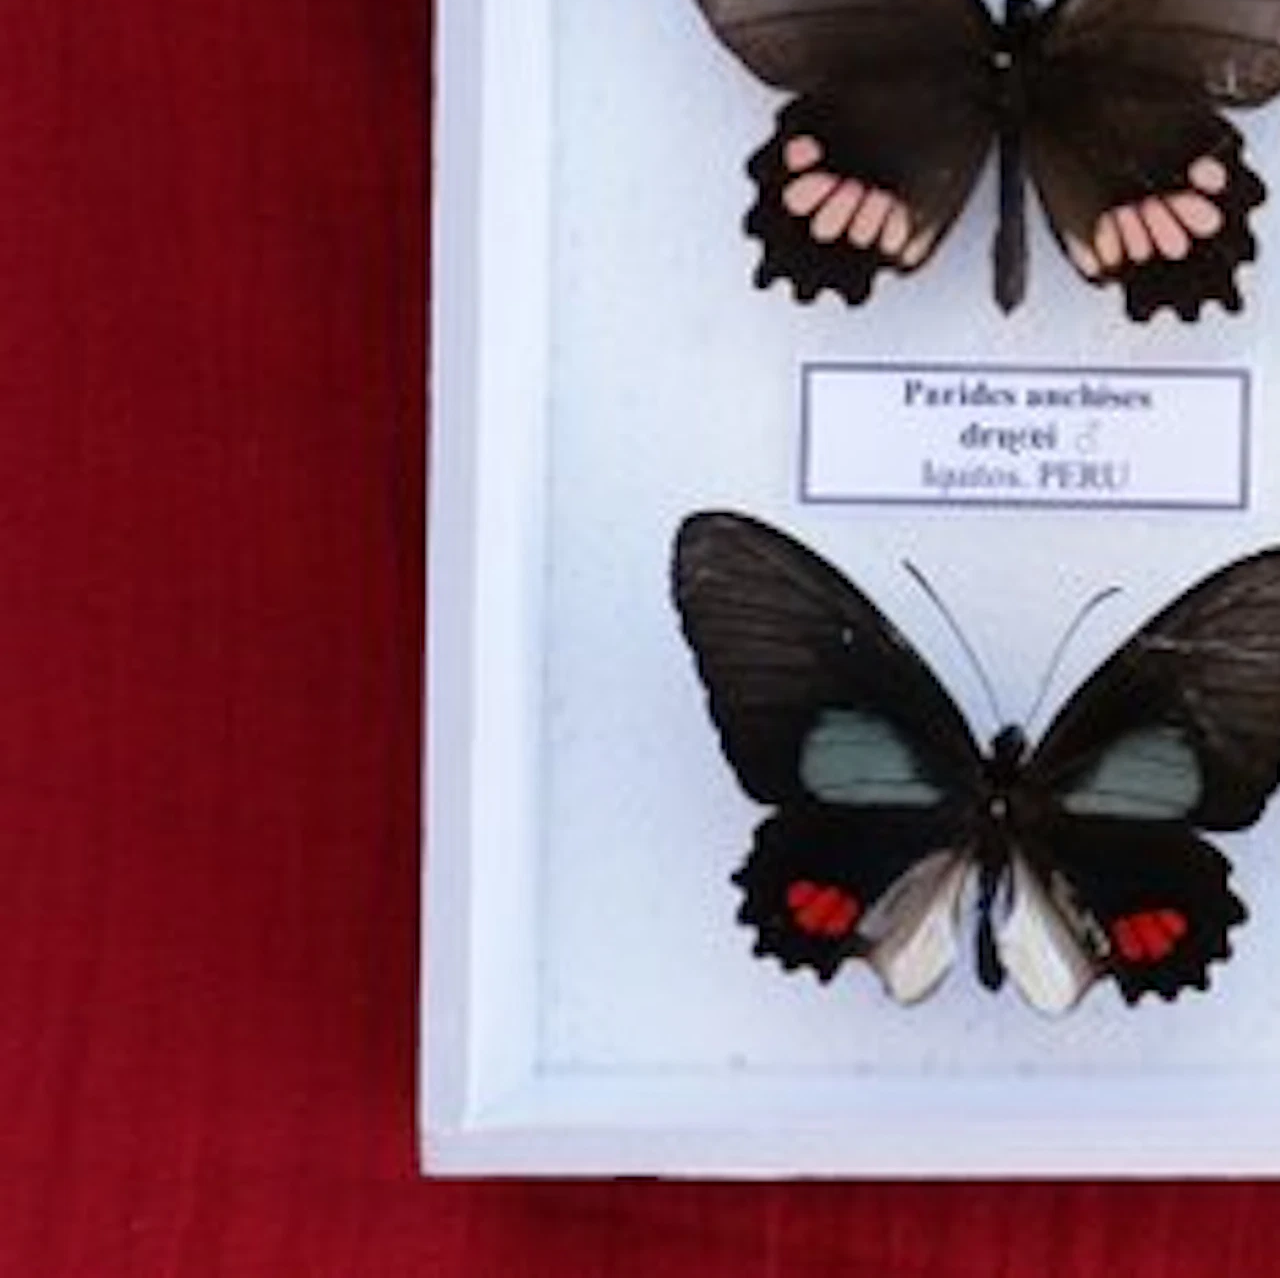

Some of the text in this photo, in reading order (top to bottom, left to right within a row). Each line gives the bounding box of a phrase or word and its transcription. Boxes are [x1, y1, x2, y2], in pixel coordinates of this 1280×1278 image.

[903, 379, 1153, 409] Parides anchises
[1038, 462, 1130, 489] PERU
